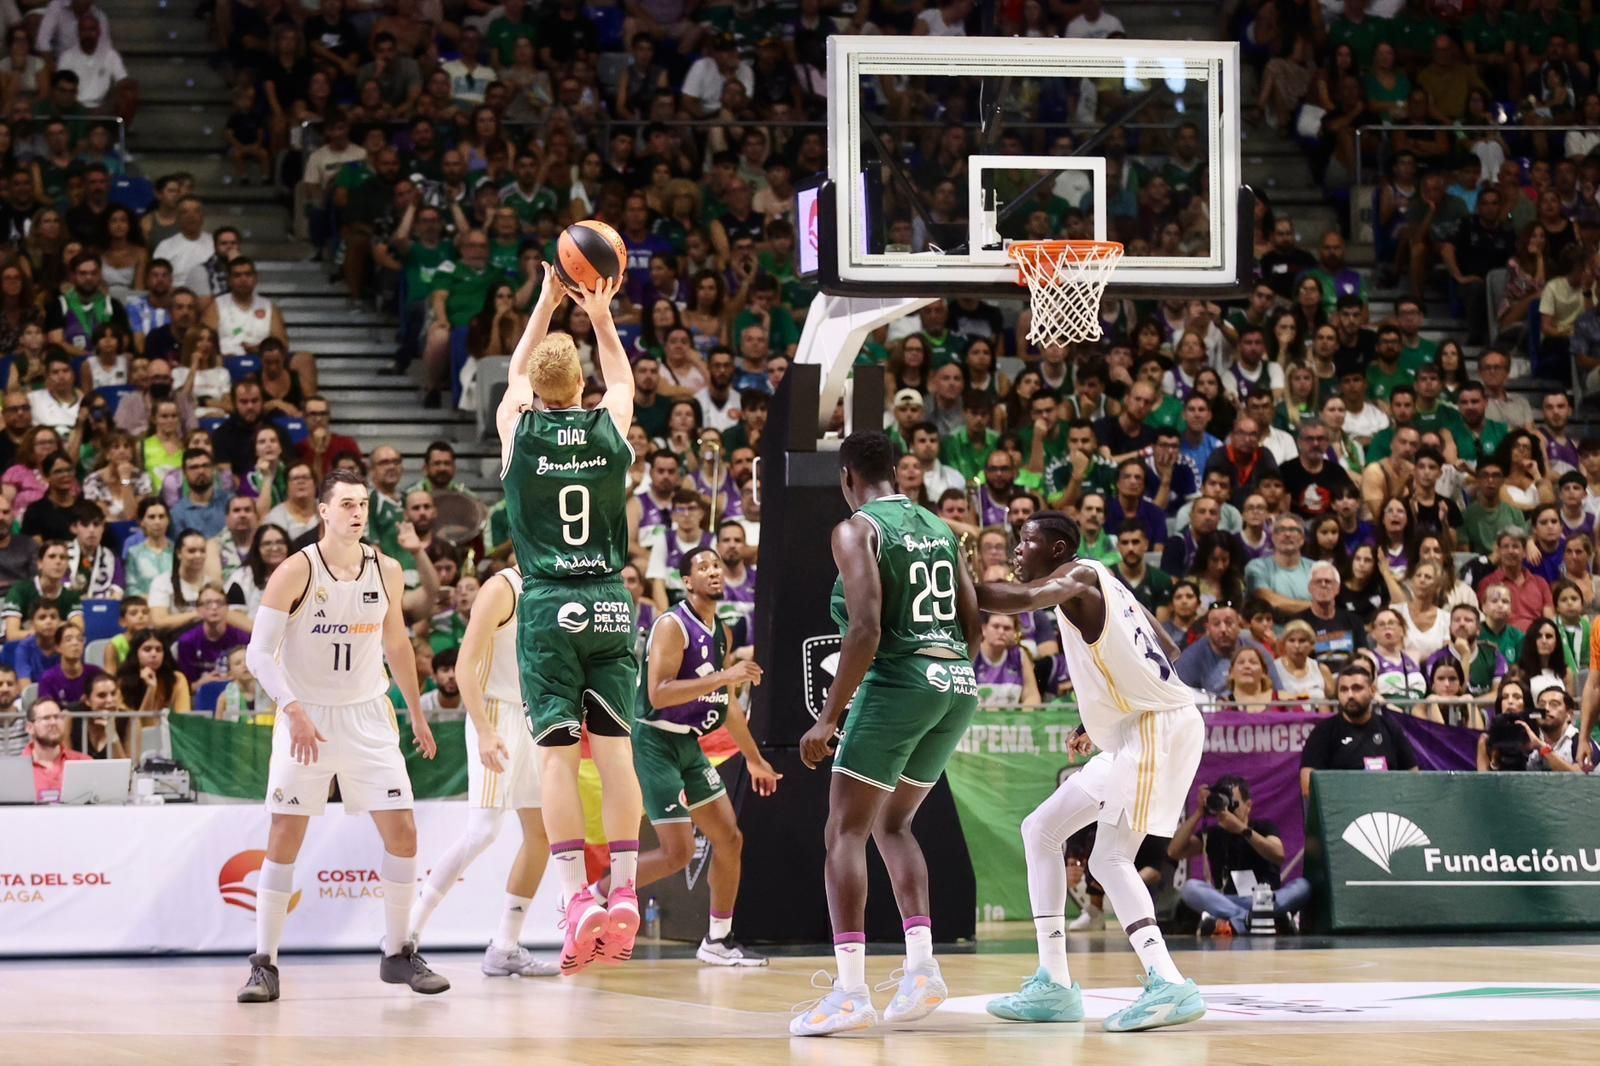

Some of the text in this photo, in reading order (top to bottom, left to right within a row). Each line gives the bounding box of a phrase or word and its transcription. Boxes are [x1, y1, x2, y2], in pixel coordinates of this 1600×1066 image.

[557, 426, 587, 446] DÍAZ
[558, 484, 590, 546] 9
[909, 560, 956, 623] 29
[593, 601, 630, 614] COSTA
[594, 613, 631, 624] DEL SOL
[331, 642, 351, 671] 11
[952, 675, 968, 685] DEL
[0, 872, 111, 886] TA DEL SOL
[317, 869, 381, 883] COSTA
[0, 890, 44, 902] AGA
[319, 885, 385, 899] MÁLAG
